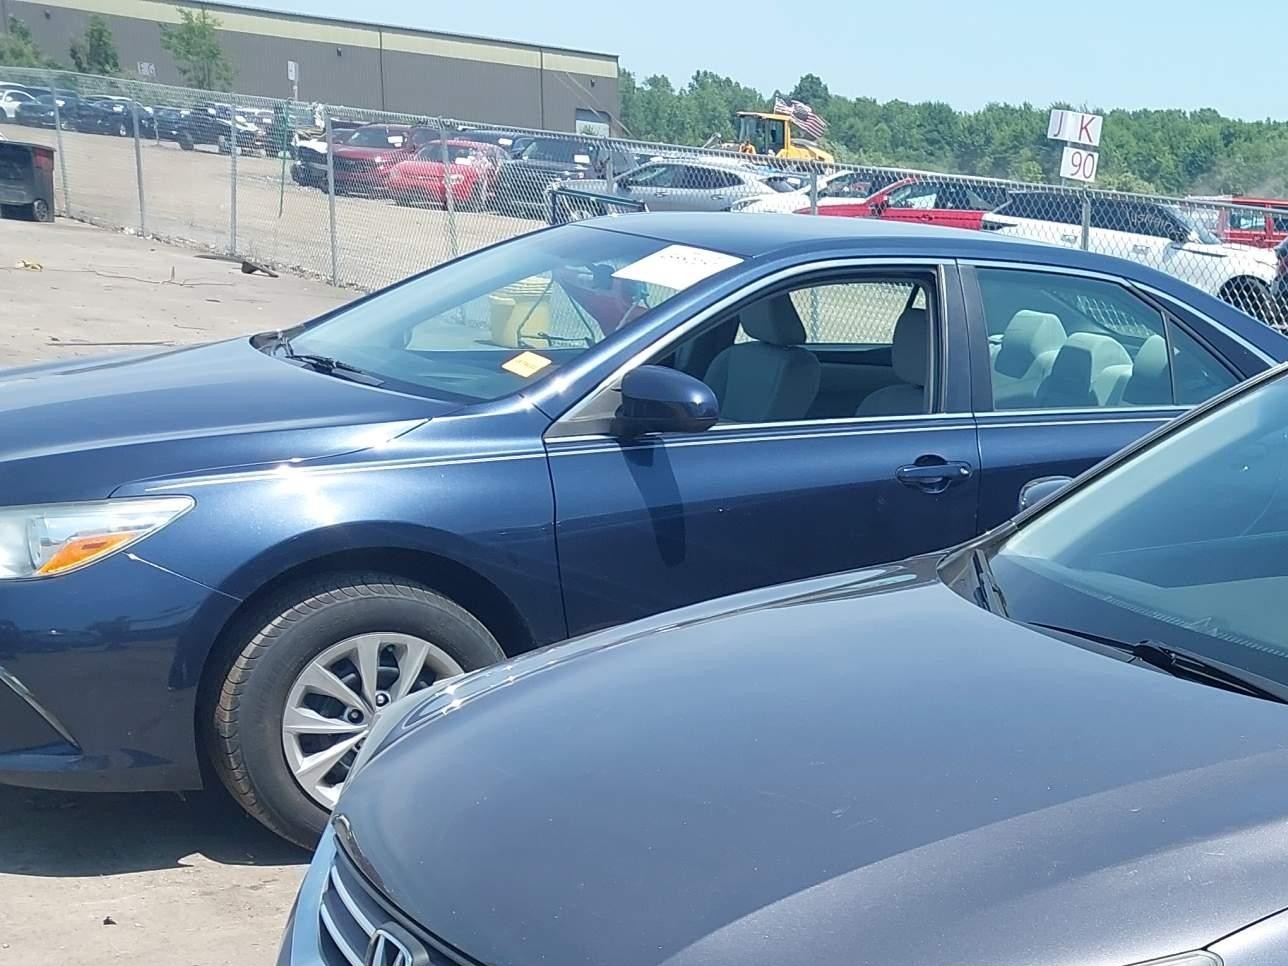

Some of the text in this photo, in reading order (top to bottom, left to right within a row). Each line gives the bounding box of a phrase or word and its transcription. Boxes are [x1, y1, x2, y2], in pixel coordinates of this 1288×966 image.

[1054, 112, 1096, 142] J K
[1071, 151, 1095, 179] 90
